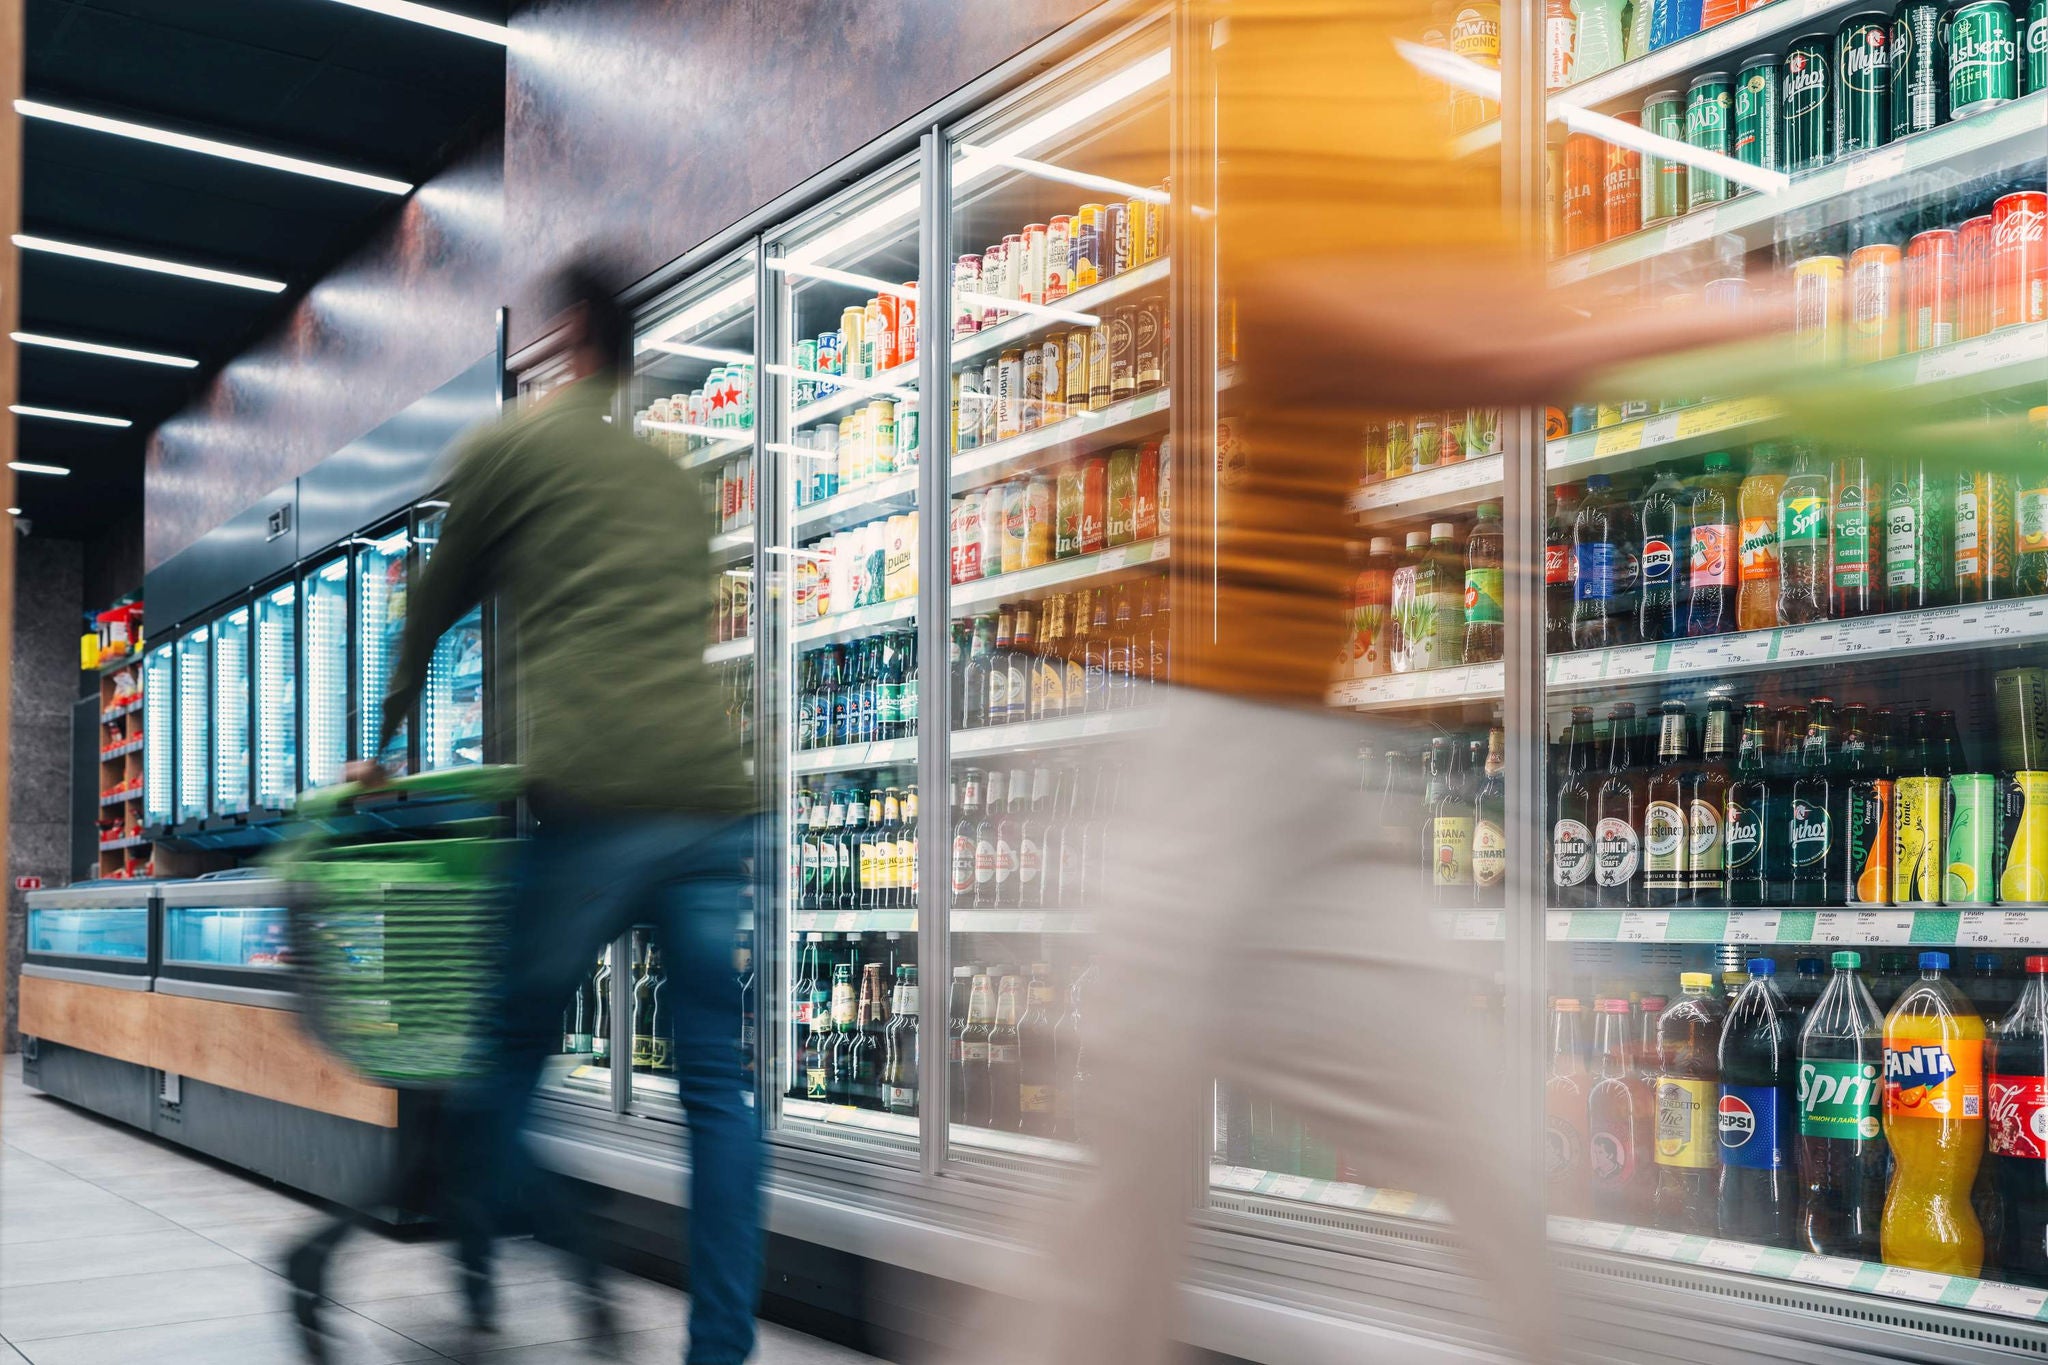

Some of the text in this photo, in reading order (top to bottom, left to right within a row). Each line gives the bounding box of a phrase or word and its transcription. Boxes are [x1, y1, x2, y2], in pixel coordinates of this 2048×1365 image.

[1688, 105, 1720, 134] DAB
[1846, 518, 1861, 526] ICE
[1893, 516, 1906, 524] ICE
[1837, 523, 1868, 537] tea
[1888, 520, 1912, 535] tea
[1840, 549, 1862, 557] GREEN
[1993, 627, 2010, 635] 1.79
[1846, 643, 1862, 651] 2.19
[1664, 717, 1672, 751] Warsteiner
[1865, 800, 1873, 824] Orange
[1903, 801, 1911, 826] tonic
[1852, 792, 1868, 863] green
[1884, 1047, 1954, 1077] FANTA
[1719, 1115, 1752, 1129] PEPSI
